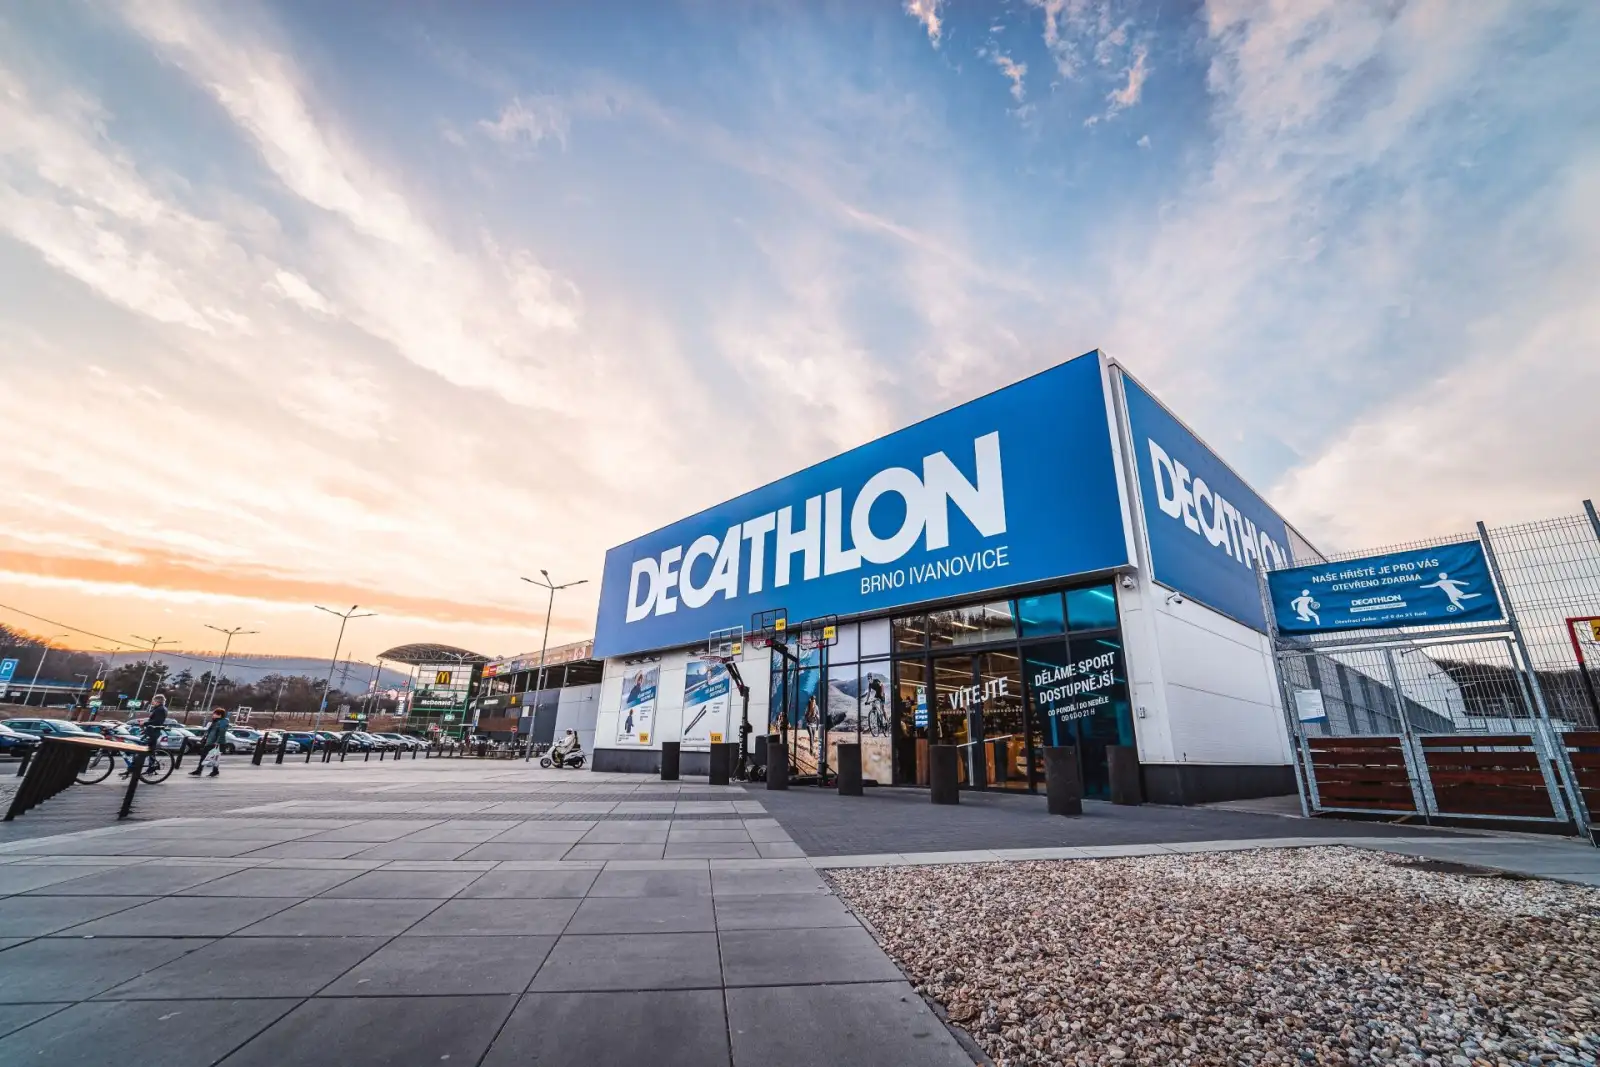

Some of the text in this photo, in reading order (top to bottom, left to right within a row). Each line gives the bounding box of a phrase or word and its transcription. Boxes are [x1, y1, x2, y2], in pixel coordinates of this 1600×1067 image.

[626, 431, 1007, 623] DECATHLON
[861, 545, 1010, 595] BRNO IVANOVICE
[1312, 558, 1440, 584] NAŠE HŘIŠTĚ JE PRO VÁS
[1332, 573, 1422, 592] OTEVŘENO ZDARMA
[1351, 594, 1402, 606] DECATHLON
[1035, 651, 1115, 687] DĚLÁME SPORT
[949, 676, 1009, 710] VÍTEJTE
[1039, 669, 1115, 704] DOSTUPNĚJŠÍ
[1088, 695, 1110, 707] NEDĚLE
[1083, 709, 1089, 717] 21
